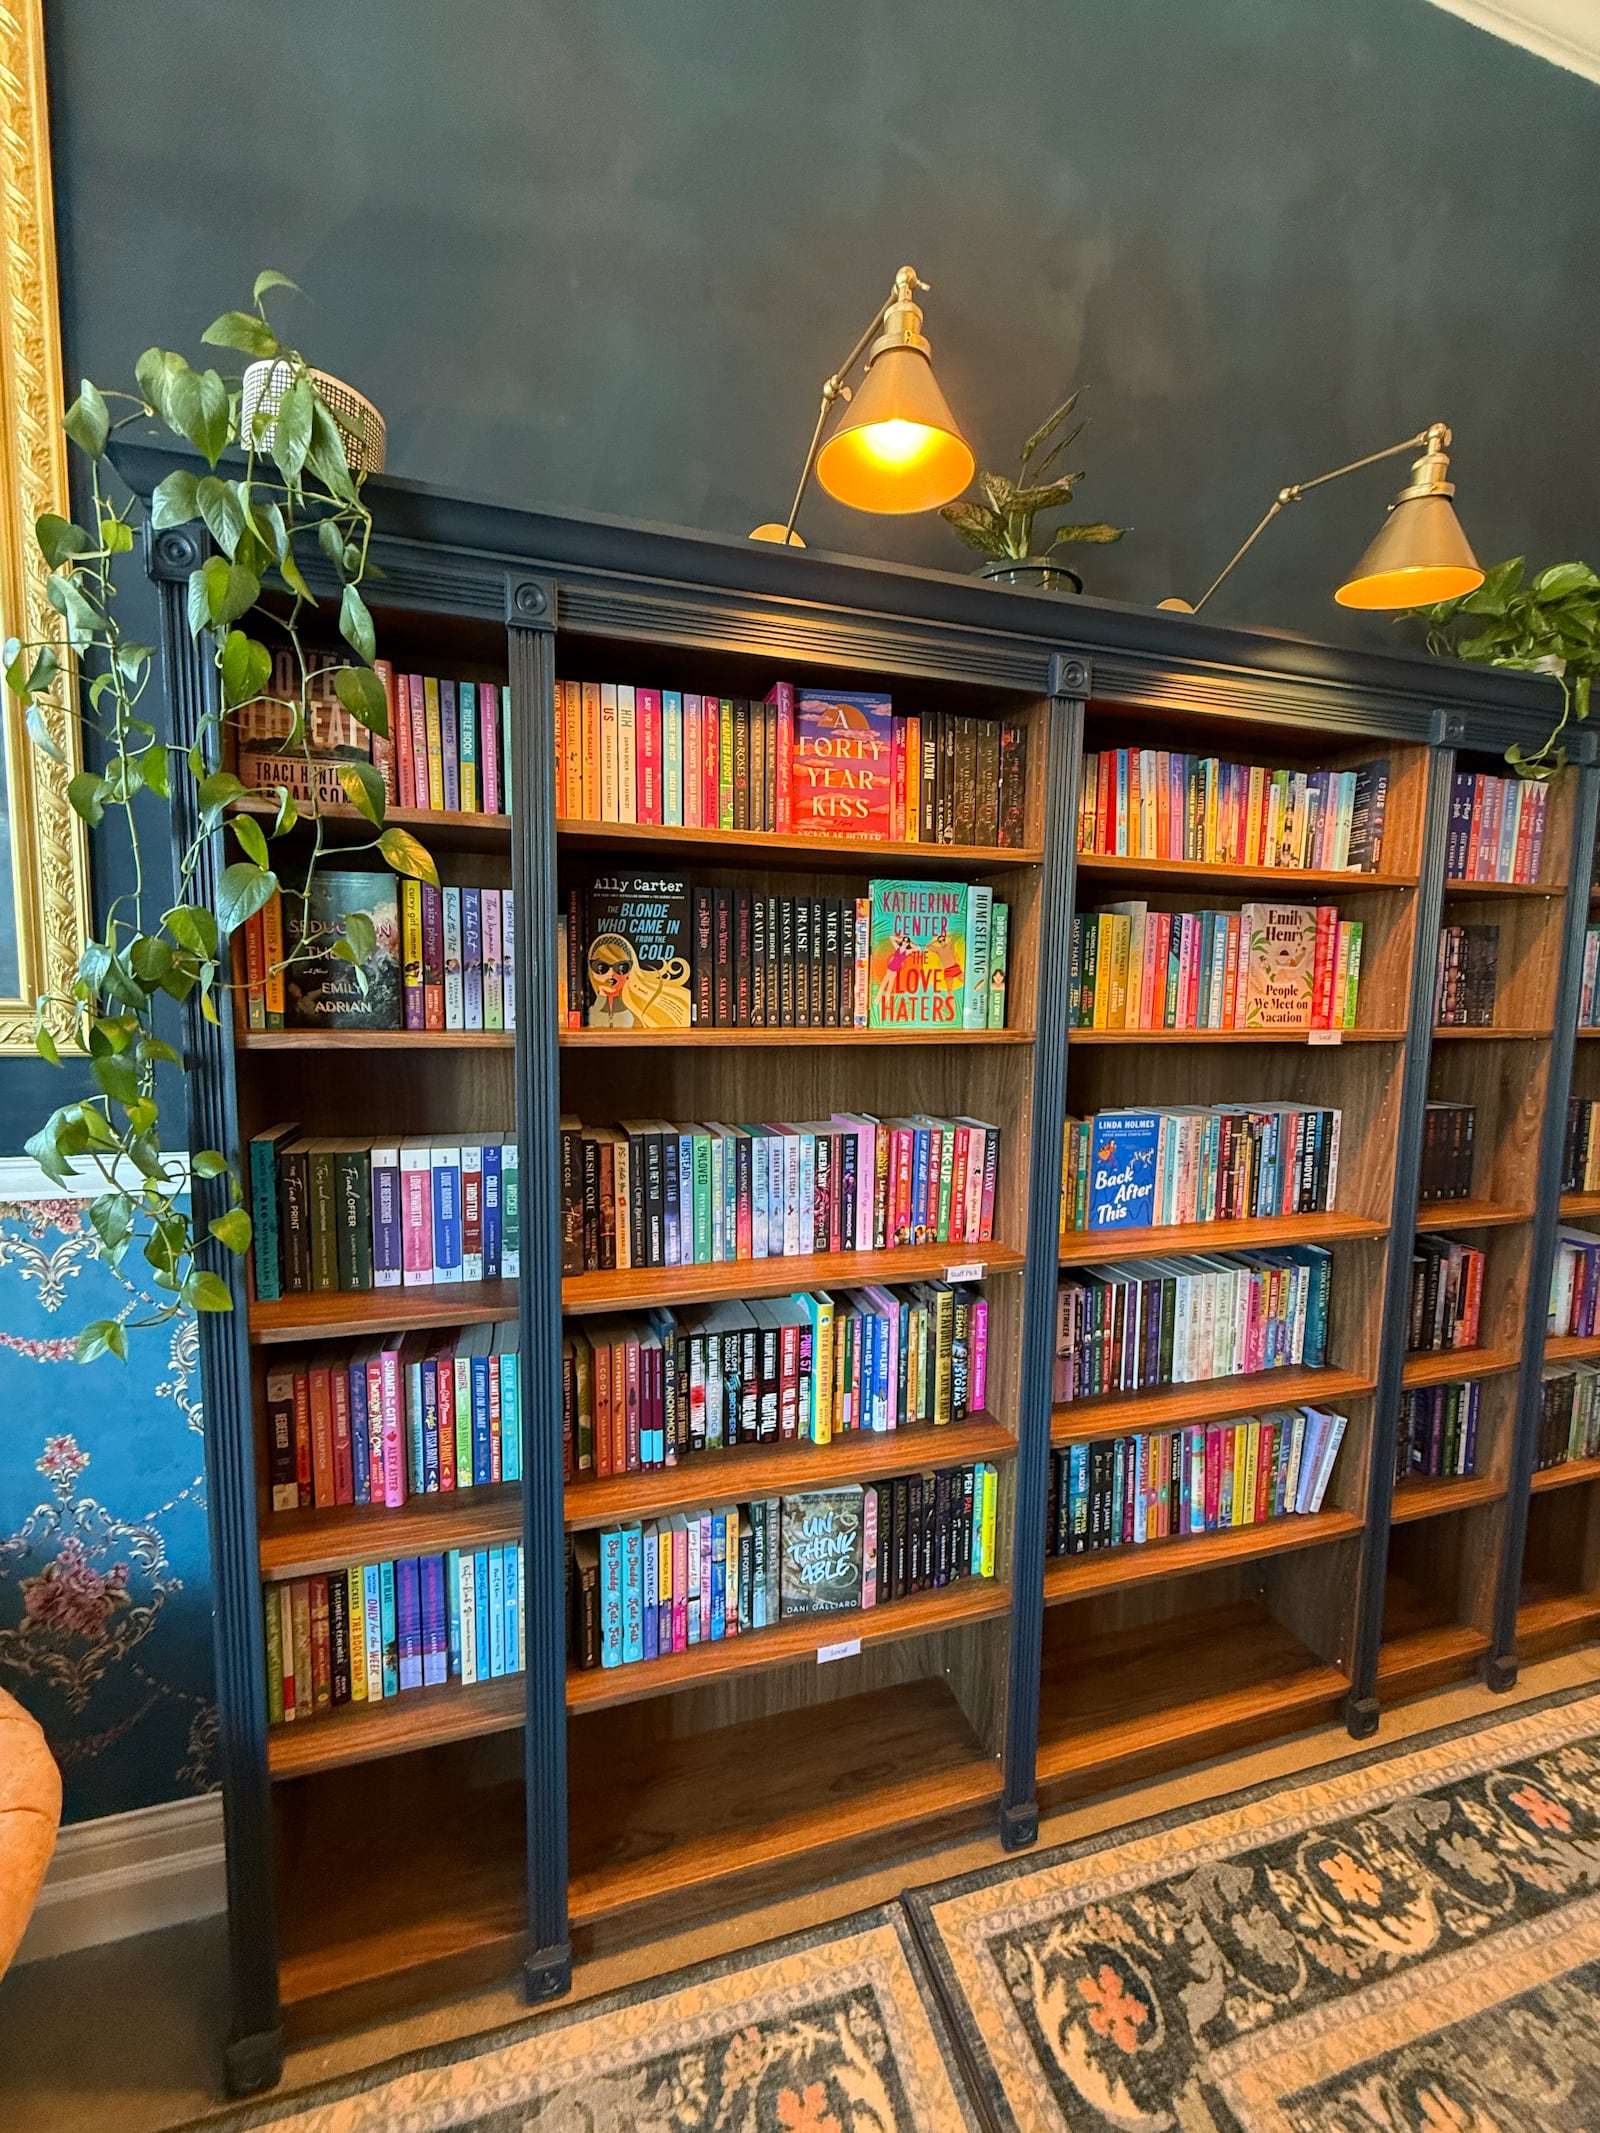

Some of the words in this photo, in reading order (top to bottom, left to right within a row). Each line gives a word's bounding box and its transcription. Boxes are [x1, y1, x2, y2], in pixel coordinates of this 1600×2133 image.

[414, 710, 423, 739] ENEMY
[445, 700, 453, 744] OFF-LIMITS
[463, 709, 471, 729] RULE
[603, 708, 614, 722] US
[621, 709, 632, 728] HIM
[834, 709, 849, 729] A
[463, 732, 472, 755] BOOK
[722, 723, 731, 744] GAME
[723, 745, 731, 753] IS
[799, 736, 882, 761] FORTY
[256, 762, 295, 783] TRACI
[723, 755, 732, 781] AFOOT
[735, 747, 745, 776] ROSES
[807, 769, 873, 790] YEAR
[1376, 777, 1386, 808] LOTUS
[812, 798, 870, 818] KISS
[426, 888, 437, 905] plus
[594, 877, 628, 893] Ally
[633, 879, 683, 893] Carter
[408, 888, 417, 909] curvy
[466, 895, 477, 908] The
[883, 891, 960, 914] KATHERINE
[409, 913, 419, 925] girl
[429, 908, 437, 924] size
[620, 903, 669, 918] BLONDE
[1268, 909, 1303, 926] Emily
[598, 918, 627, 933] WHO
[629, 919, 664, 934] CAME
[666, 920, 680, 934] IN
[754, 903, 763, 953] GRAVITY
[797, 907, 807, 952] PRAISE
[826, 912, 837, 954] MERCY
[844, 910, 852, 938] KEEP
[894, 915, 948, 937] CENTER
[974, 894, 988, 974] HOMESEEKING
[996, 916, 1004, 935] DROP
[1265, 927, 1306, 943] Henry
[426, 928, 438, 955] player
[639, 945, 675, 960] COLD
[844, 941, 852, 957] ME
[996, 937, 1004, 955] DEAD
[1216, 933, 1225, 958] BEACH
[911, 951, 929, 965] THE
[322, 982, 364, 993] EMILY
[895, 968, 942, 994] LOVE
[1265, 985, 1299, 997] People
[315, 1001, 372, 1012] ADRIAN
[881, 996, 956, 1022] HATERS
[1255, 998, 1270, 1009] We
[1271, 998, 1293, 1009] Meet
[1296, 1001, 1308, 1009] on
[1260, 1011, 1302, 1023] Vacation
[1099, 1120, 1123, 1129] LINDA
[1124, 1120, 1155, 1129] HOLMES
[1306, 1115, 1316, 1152] COLLEEN
[586, 1145, 594, 1184] KRESLEY
[698, 1147, 707, 1185] UNLOVED
[818, 1141, 827, 1170] CAMERA
[846, 1140, 854, 1169] RULE
[940, 1132, 954, 1183] PICK-UP
[986, 1141, 995, 1172] SYLVIA
[342, 1167, 360, 1199] Final
[818, 1173, 827, 1187] SHY
[985, 1173, 994, 1192] DAY
[1095, 1169, 1134, 1190] Back
[1303, 1155, 1313, 1189] HOOVER
[486, 1176, 497, 1207] COLLIDED
[587, 1187, 595, 1211] COLE
[957, 1193, 963, 1202] AT
[1114, 1184, 1152, 1204] After
[290, 1206, 299, 1230] PRINT
[348, 1198, 356, 1227] OFFER
[955, 1204, 963, 1229] NIGHT
[1097, 1204, 1128, 1224] This
[941, 1297, 952, 1312] THE
[1062, 1308, 1070, 1337] STRIKER
[800, 1334, 811, 1358] PUNK
[822, 1329, 830, 1352] TOTAL
[941, 1315, 952, 1358] FAVORITES
[666, 1360, 674, 1382] GIRL
[801, 1360, 811, 1372] 57
[384, 1360, 395, 1397] SUMMER
[821, 1356, 829, 1402] DREAMBOAT
[940, 1374, 949, 1397] LAYNE
[386, 1408, 396, 1427] CITY
[667, 1386, 675, 1444] ANONYMOUS
[711, 1386, 719, 1434] credence
[761, 1393, 777, 1434] NIGHTFALL
[387, 1447, 396, 1465] ALEX
[389, 1467, 398, 1491] ASTER
[964, 1473, 972, 1494] PEN
[802, 1511, 834, 1537] UN
[607, 1540, 619, 1558] Sky
[626, 1536, 639, 1554] Sky
[755, 1526, 764, 1551] SWEET
[787, 1532, 856, 1567] THINK
[756, 1553, 763, 1563] ON
[607, 1561, 620, 1592] Daddy
[627, 1557, 639, 1588] Daddy
[742, 1557, 750, 1583] FOSTER
[801, 1555, 849, 1585] ABLE
[352, 1581, 360, 1610] BICKERS
[368, 1599, 377, 1621] ONLY
[787, 1604, 808, 1613] DANI
[352, 1616, 361, 1634] THE
[353, 1635, 362, 1657] BOOK
[353, 1659, 362, 1682] SWAP
[370, 1651, 379, 1675] WEEK
